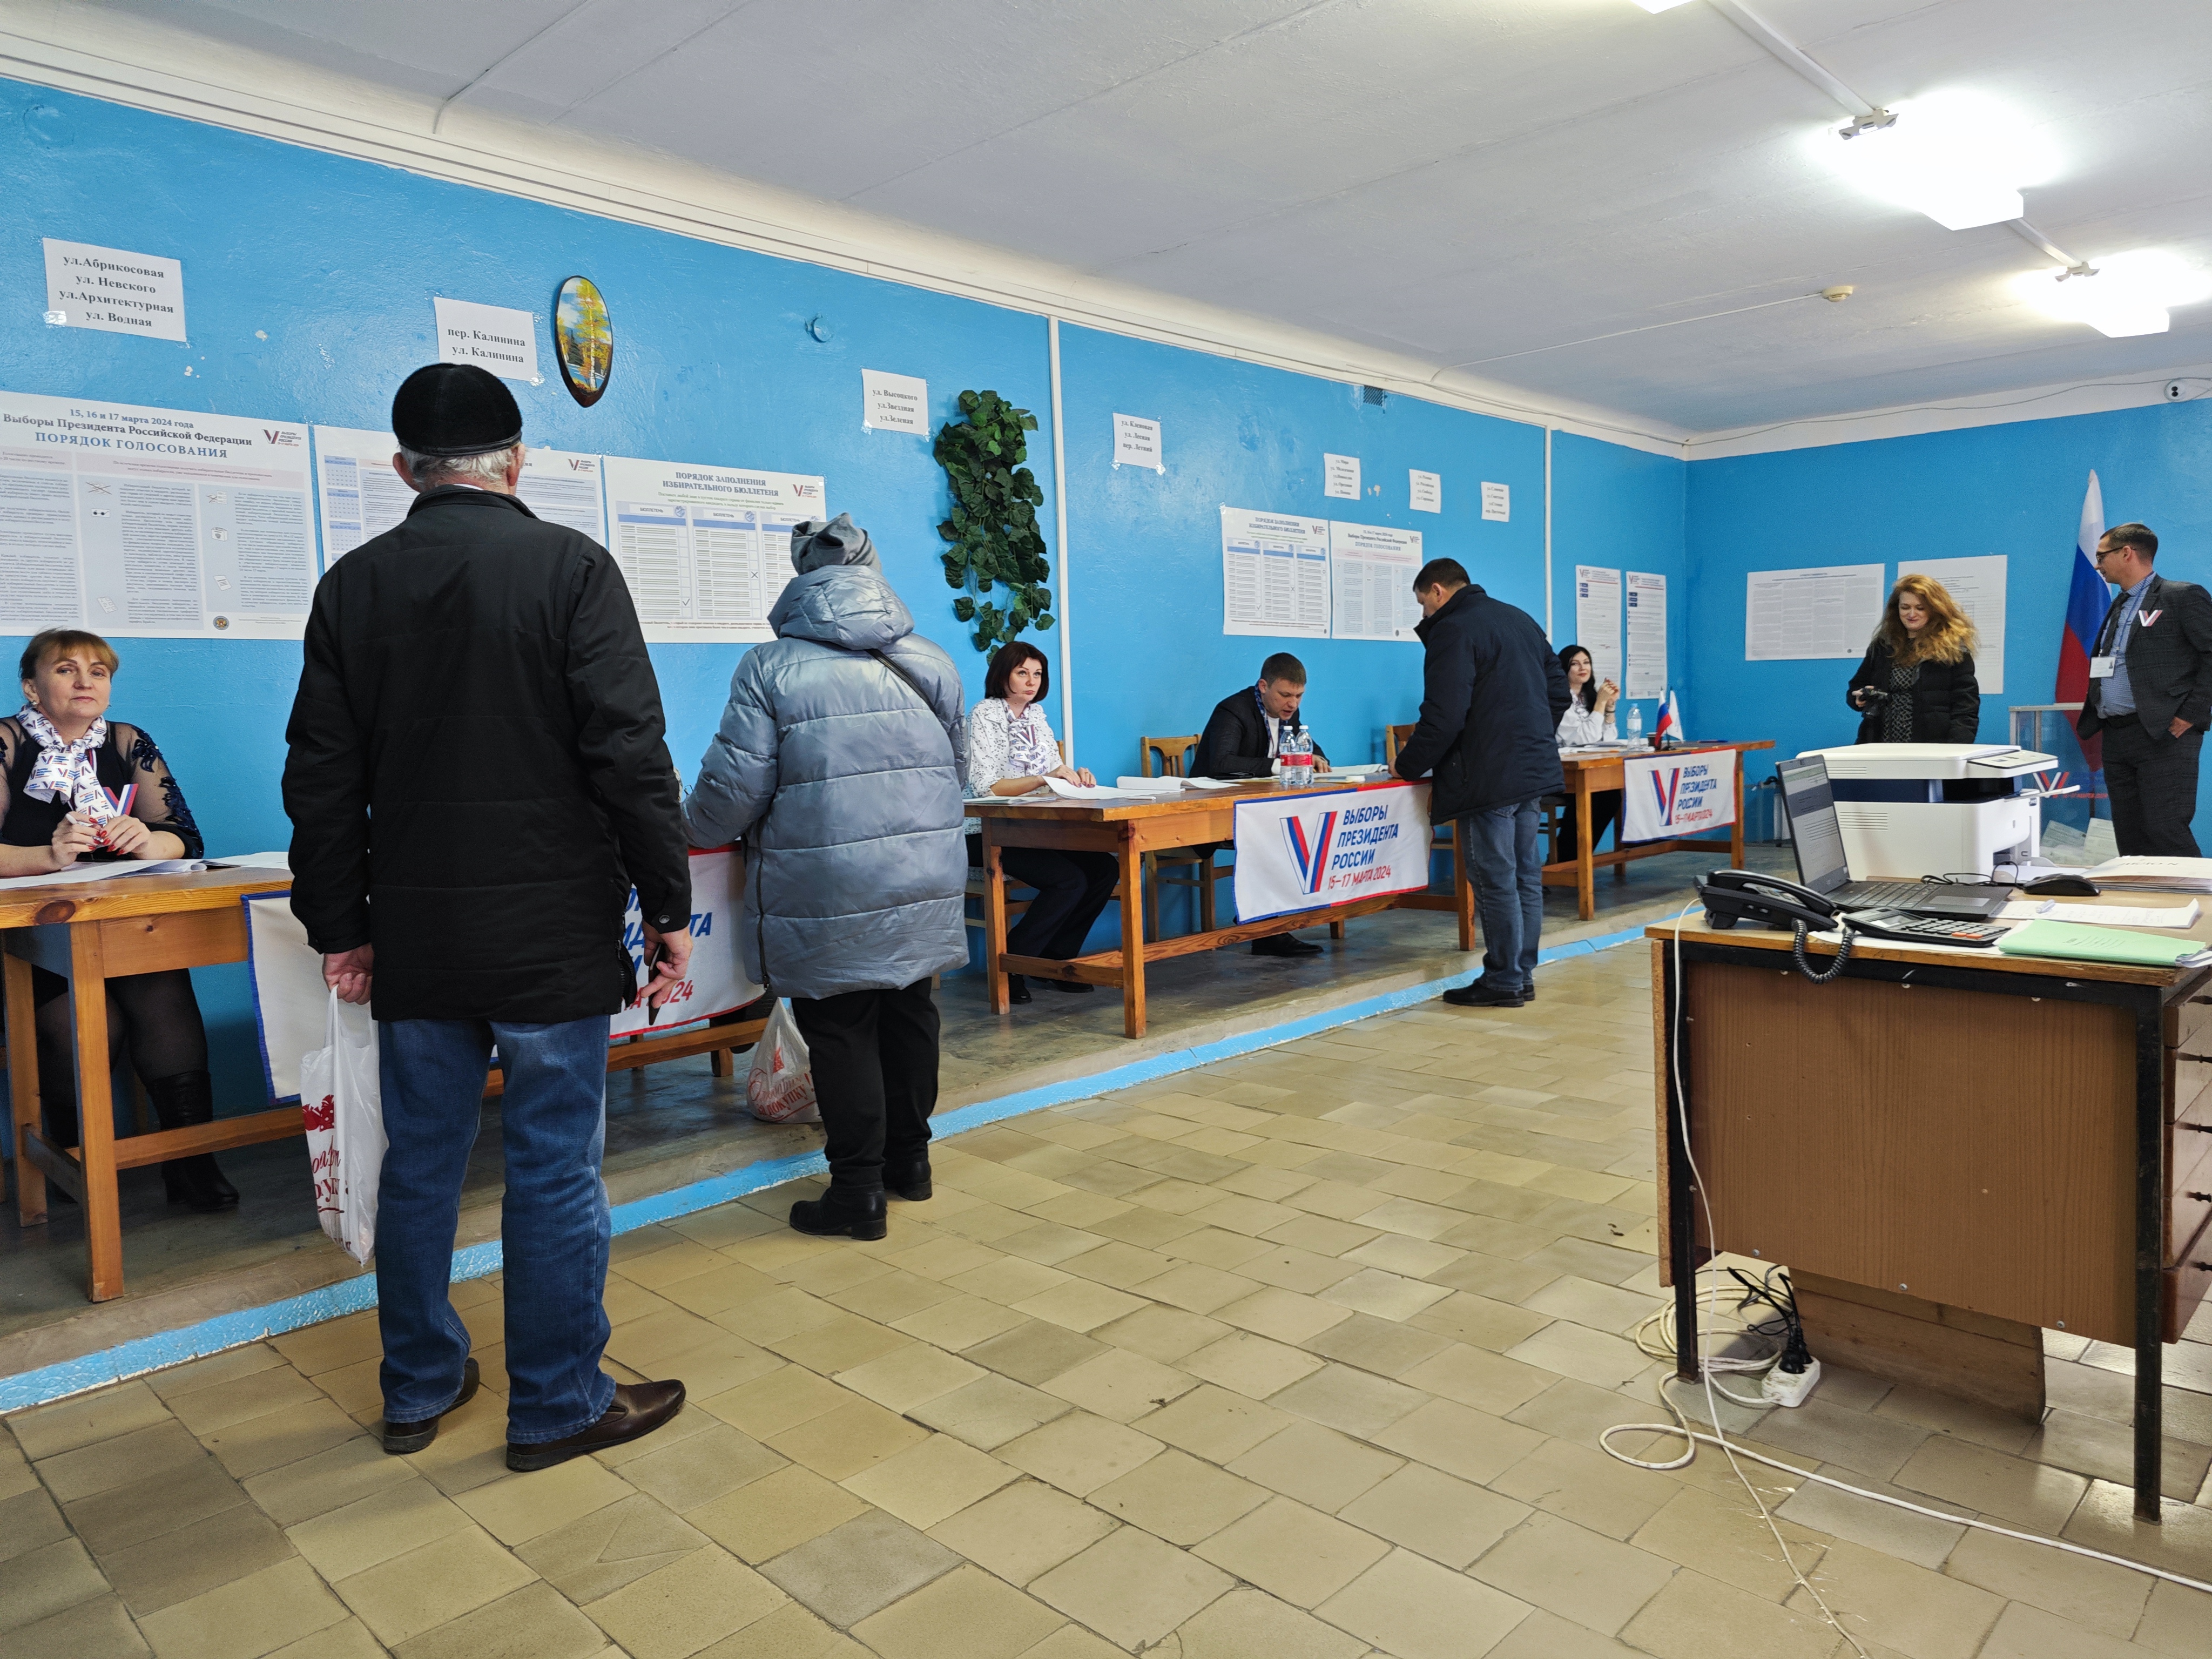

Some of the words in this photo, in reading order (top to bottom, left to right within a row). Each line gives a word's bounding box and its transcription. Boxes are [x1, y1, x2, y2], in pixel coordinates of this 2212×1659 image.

[63, 257, 164, 278] ул.Абрикосовая
[76, 276, 94, 285] ул.
[99, 277, 156, 293] Невского
[59, 291, 173, 313] ул.Архитектурная
[86, 312, 104, 321] ул.
[108, 312, 152, 327] Водная
[448, 329, 470, 340] пер.
[473, 330, 526, 347] Калинина
[451, 347, 468, 356] ул.
[471, 347, 524, 363] Калинина
[884, 389, 918, 401] Высоцкого
[70, 409, 84, 418] 15,
[121, 415, 149, 424] марта
[151, 417, 172, 426] 2024
[3, 413, 54, 428] Выборы
[57, 419, 126, 433] Президента
[129, 426, 192, 440] Российской
[194, 432, 252, 446] Федерации
[35, 432, 112, 448] ПОРЯДОК
[117, 439, 227, 458] ГОЛОСОВАНИЯ
[676, 472, 714, 482] ПОРЯДОК
[716, 475, 766, 486] ЗАПОЛНЕНИЯ
[663, 480, 732, 493] ИЗБИРАТЕЛЬНОГО
[734, 487, 779, 496] БЮЛЛЕТЕНЯ
[1683, 764, 1709, 778] ВЫБОРЫ
[1680, 779, 1717, 794] ПРЕЗИДЕНТА
[1676, 796, 1703, 811] РОССИИ
[1343, 805, 1388, 826] ВЫБОРЫ
[1337, 823, 1399, 848] ПРЕЗИДЕНТА
[1331, 848, 1375, 871] РОССИИ
[1351, 868, 1373, 886] МАРТА
[1373, 865, 1391, 881] 2024
